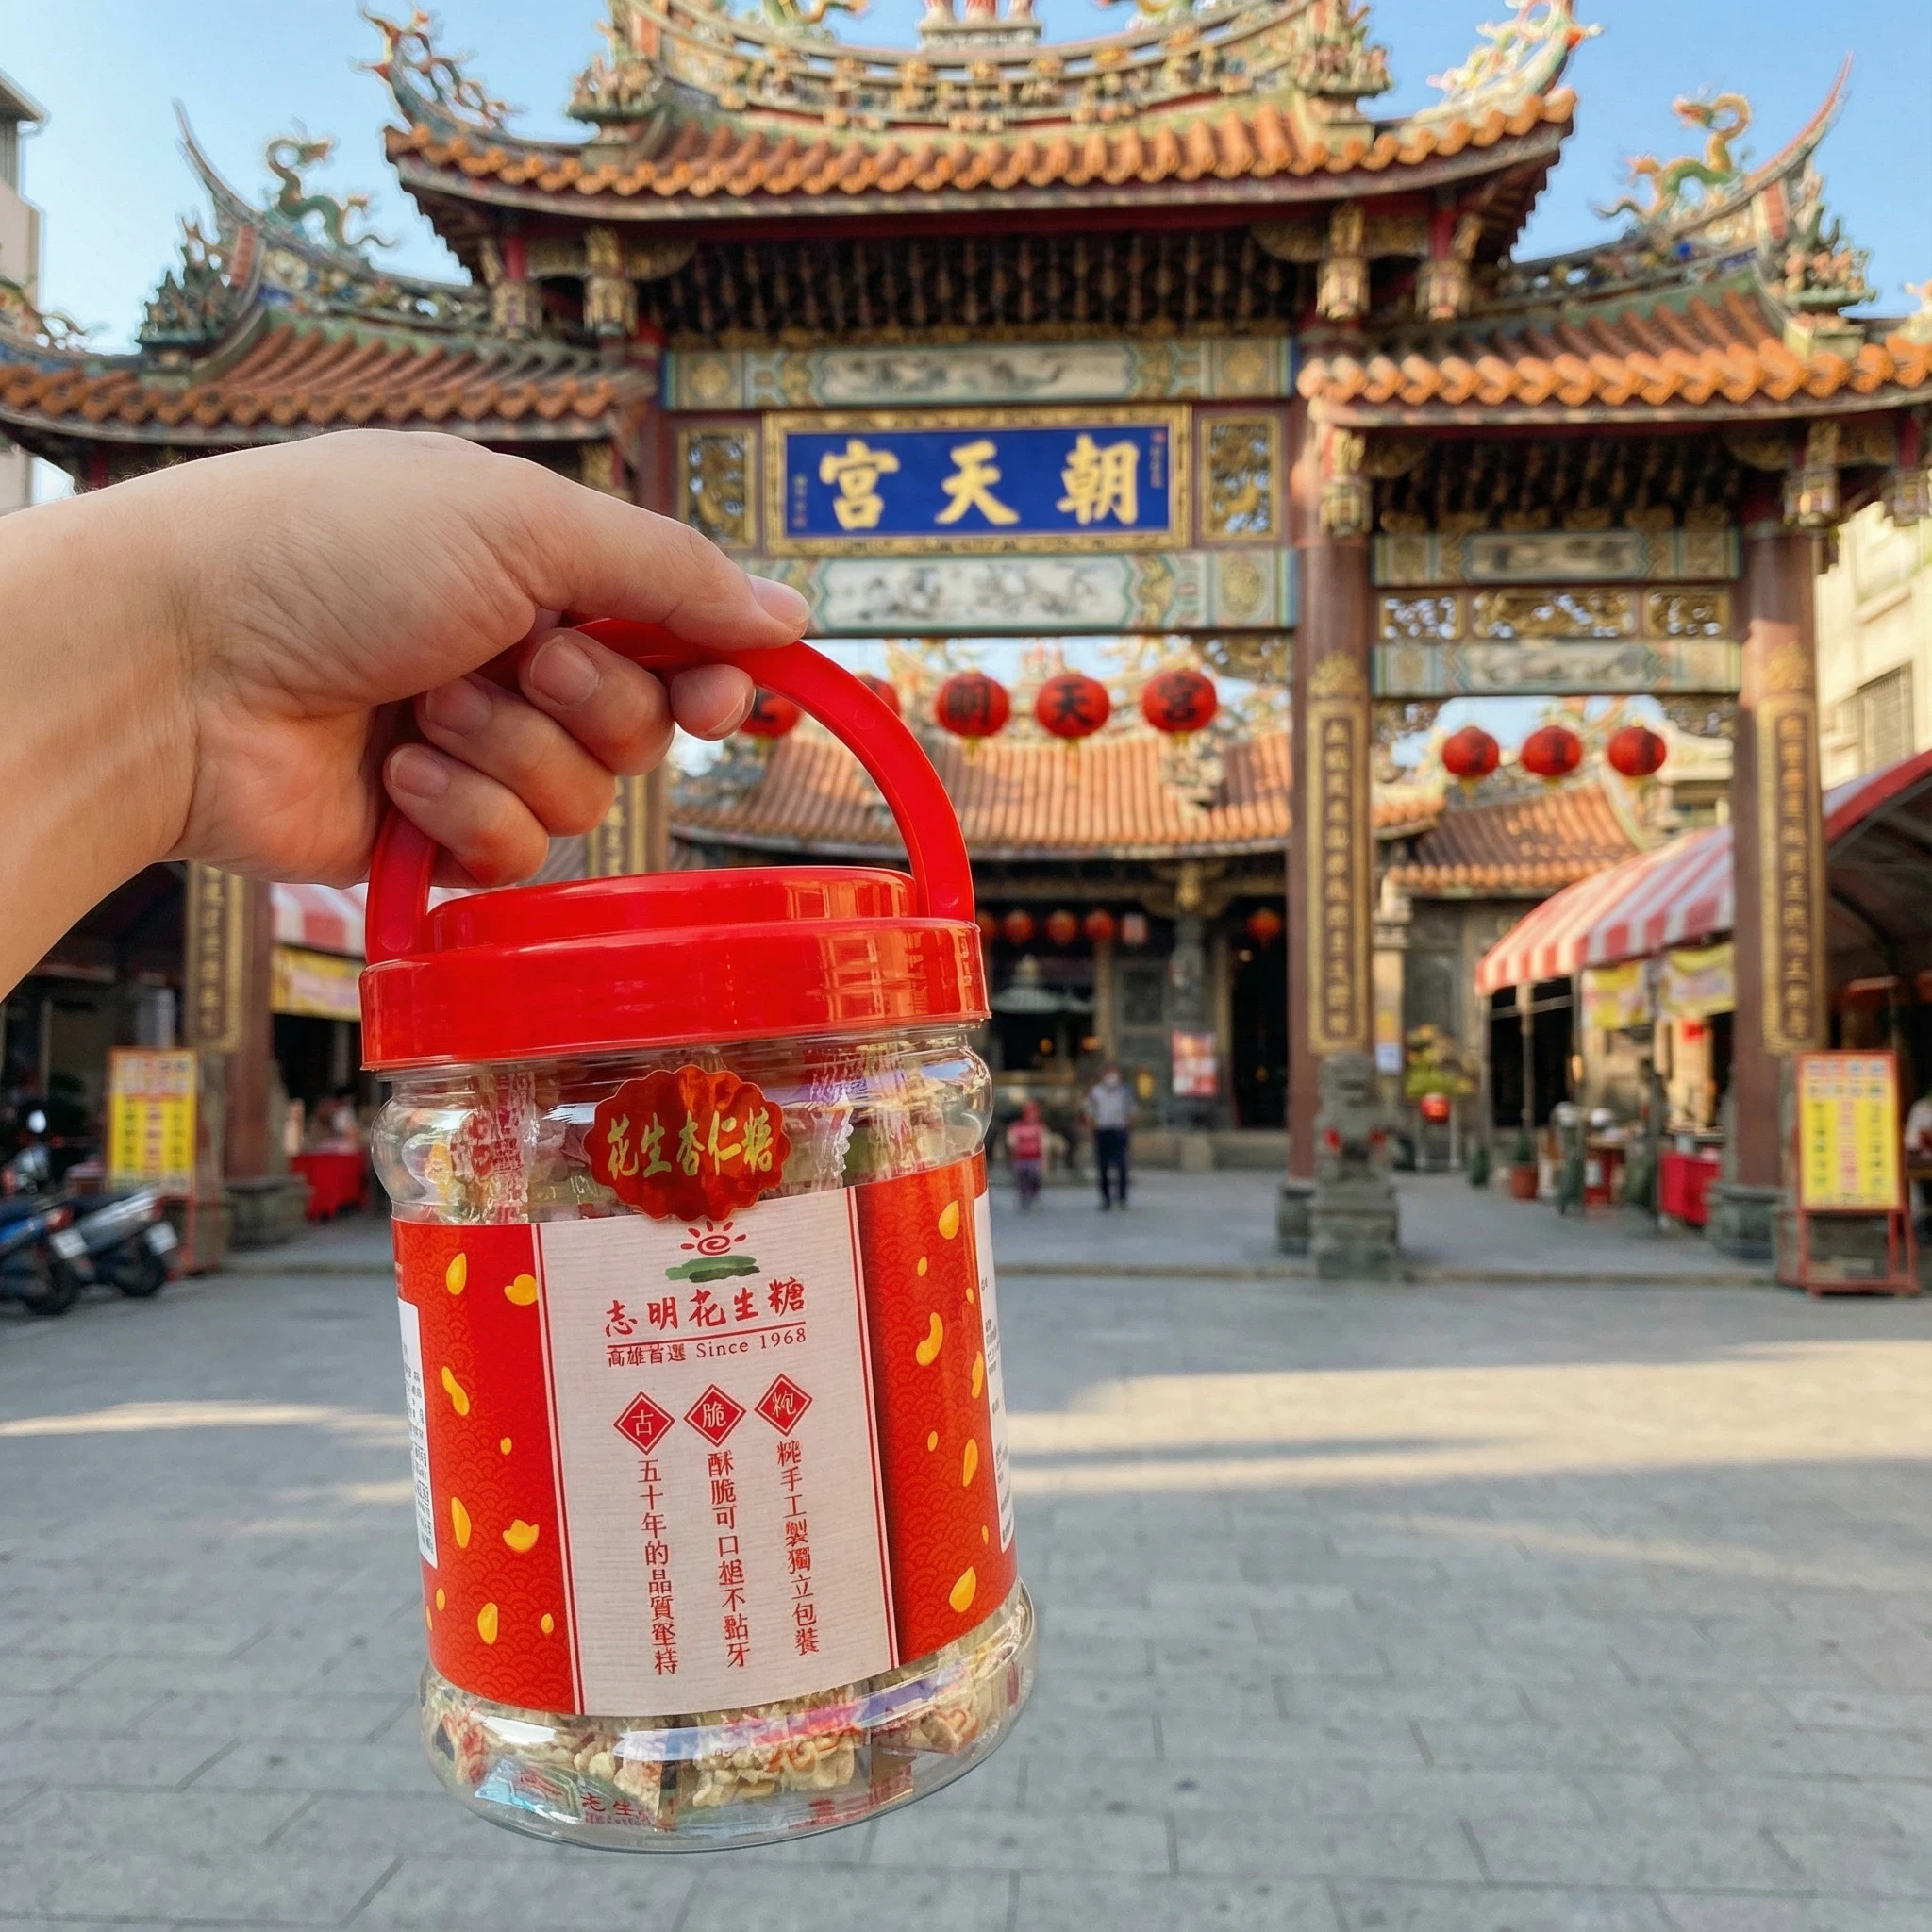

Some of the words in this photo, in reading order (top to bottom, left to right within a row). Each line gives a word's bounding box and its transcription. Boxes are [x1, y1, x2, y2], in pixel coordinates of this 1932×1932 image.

[604, 1276, 805, 1338] 志明花生糖
[696, 1341, 750, 1358] Since
[759, 1327, 808, 1350] 1968
